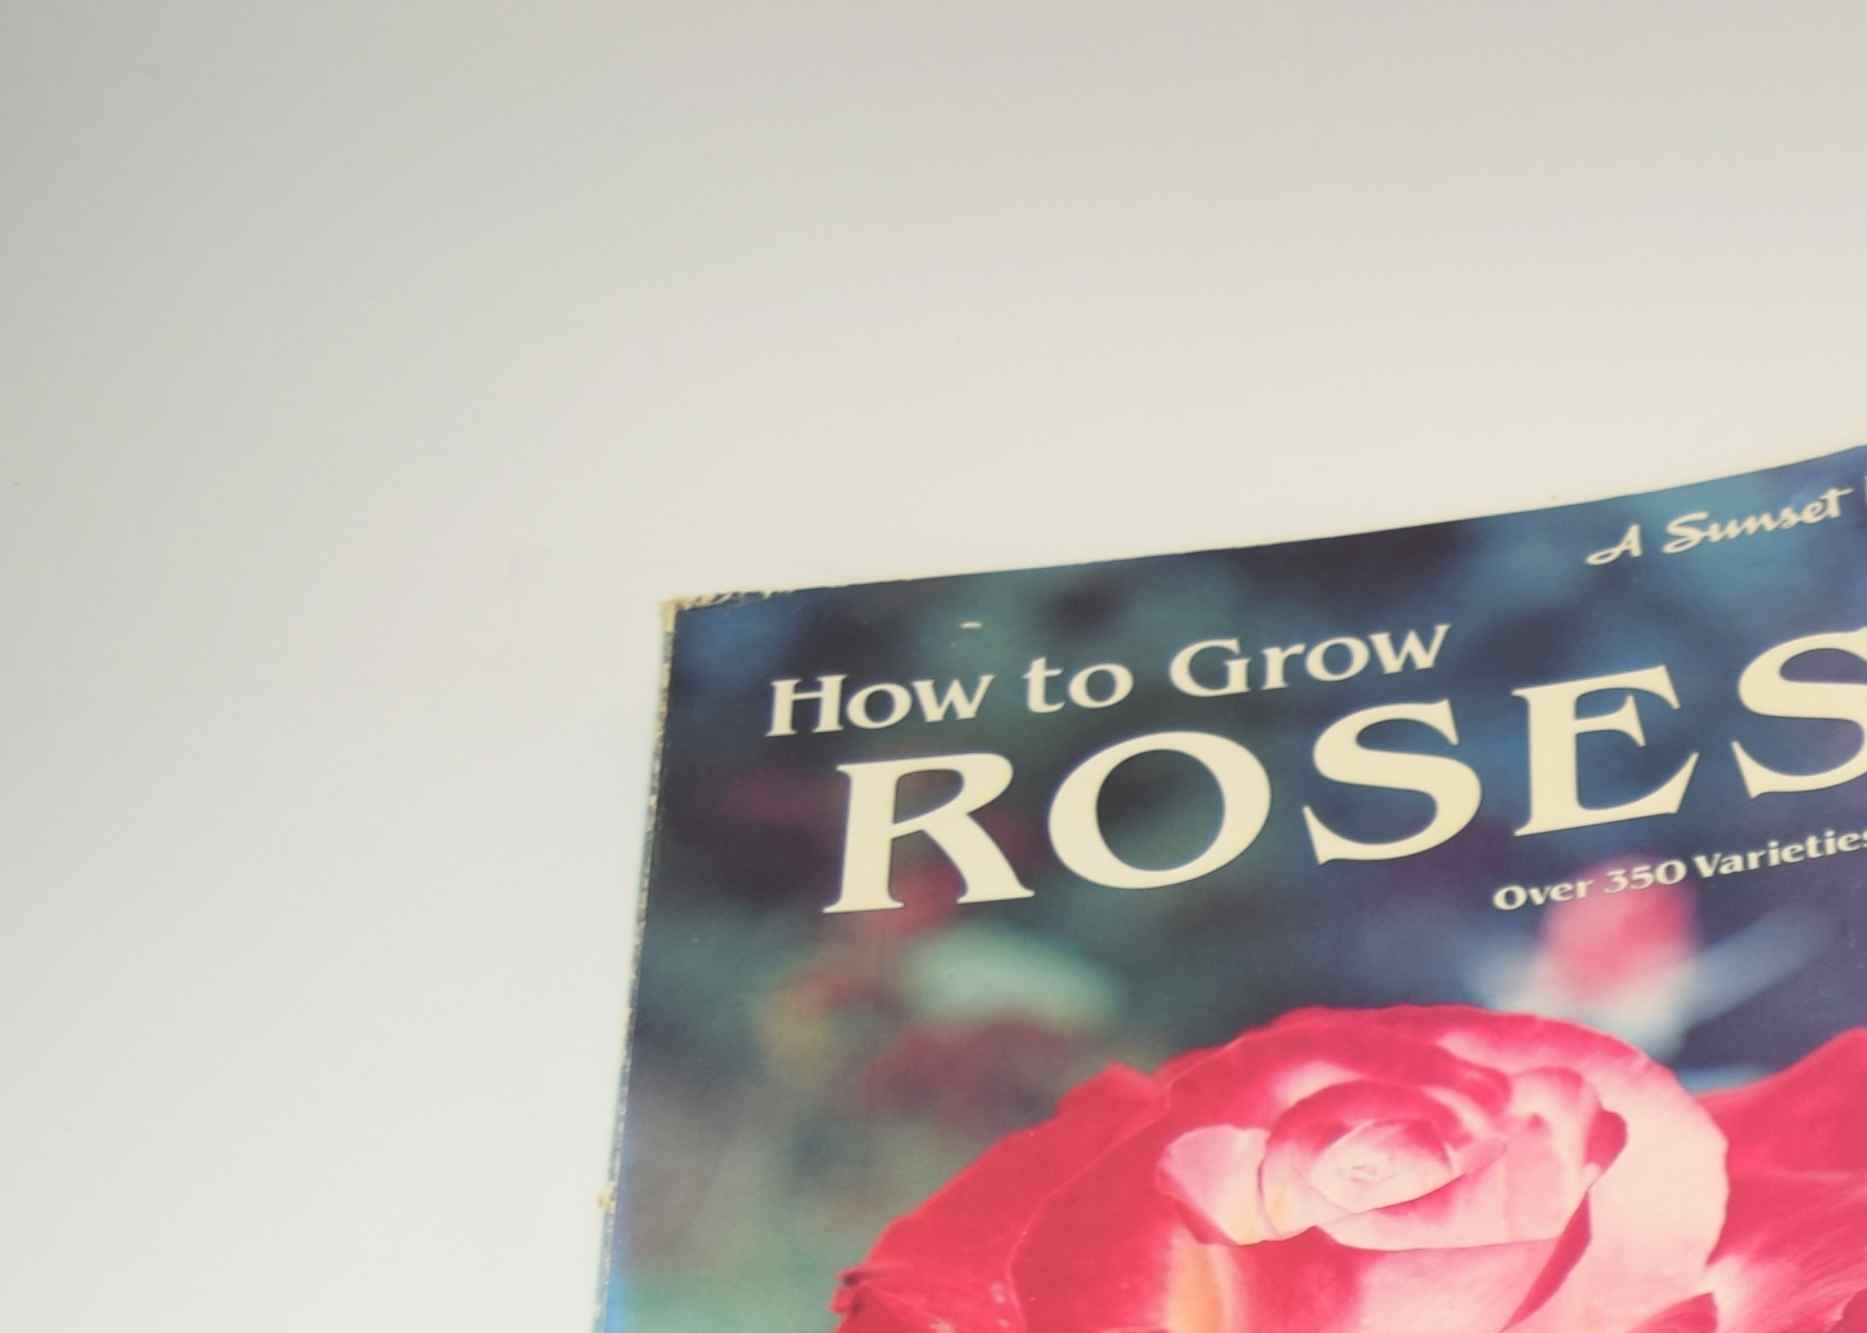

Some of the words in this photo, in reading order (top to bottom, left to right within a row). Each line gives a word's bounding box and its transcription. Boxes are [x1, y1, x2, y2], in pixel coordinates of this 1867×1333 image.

[1586, 523, 1643, 566] A
[1662, 486, 1853, 554] Sunset
[766, 672, 995, 737] How
[1023, 656, 1134, 713] to
[1169, 623, 1451, 698] Grow
[1492, 876, 1595, 911] Over
[1603, 859, 1688, 894] 350
